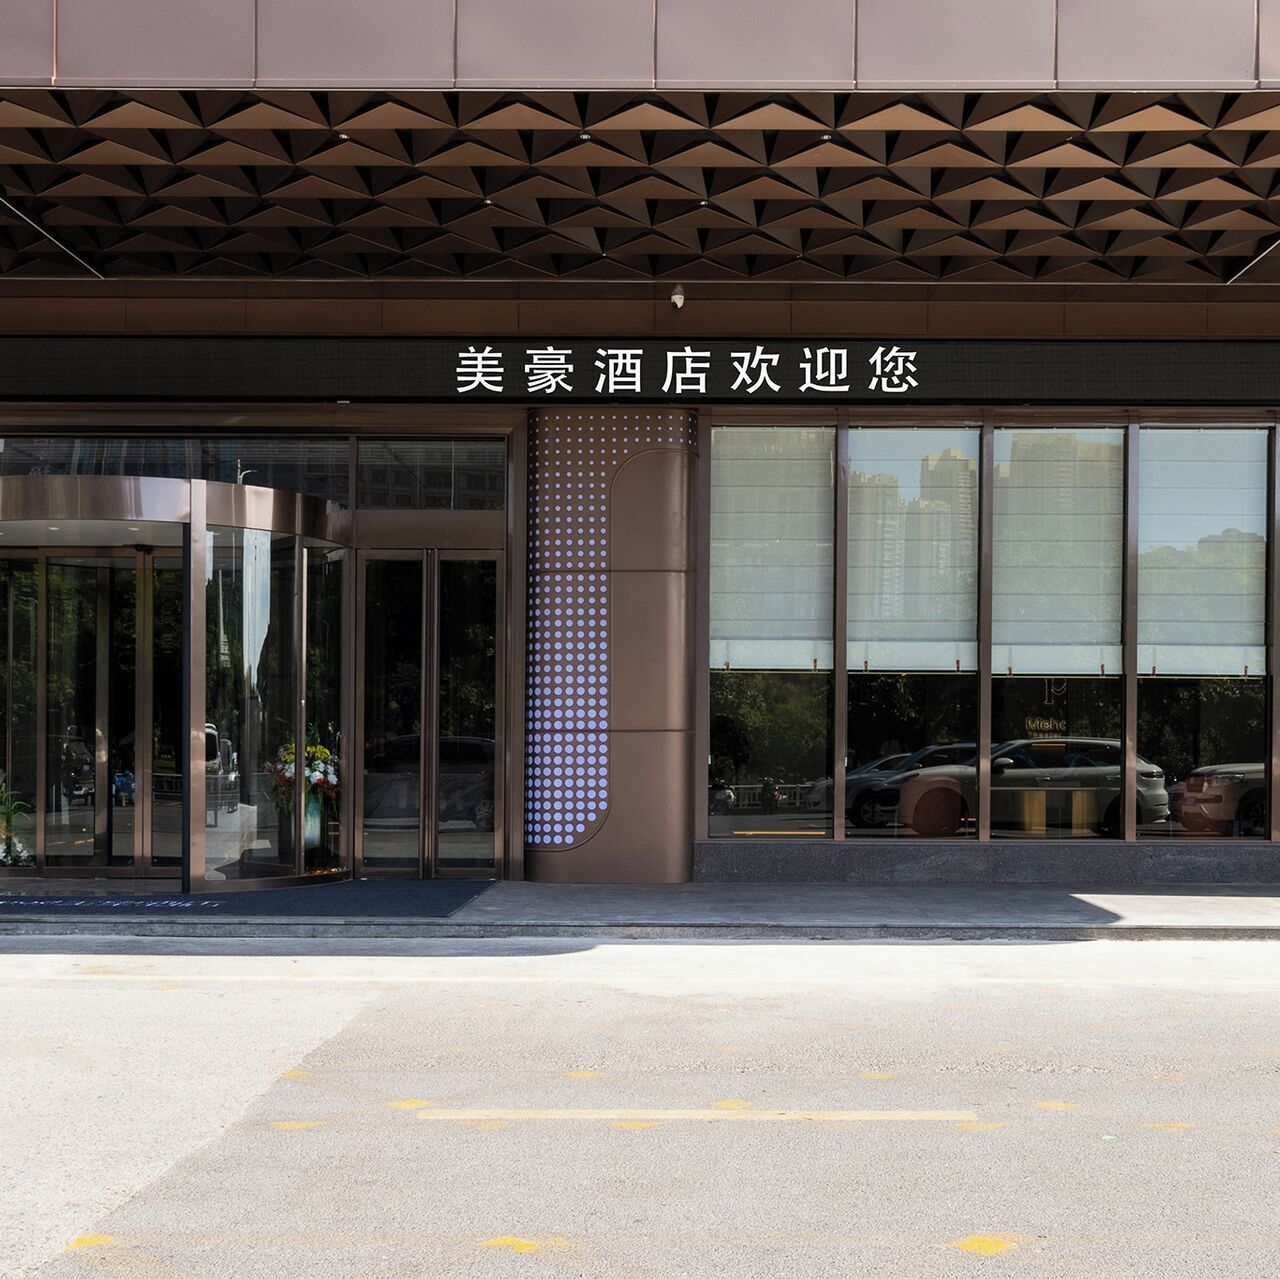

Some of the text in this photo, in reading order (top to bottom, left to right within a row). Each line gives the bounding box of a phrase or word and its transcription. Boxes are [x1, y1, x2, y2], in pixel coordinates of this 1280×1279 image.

[455, 345, 919, 394] 美豪酒店欢迎您
